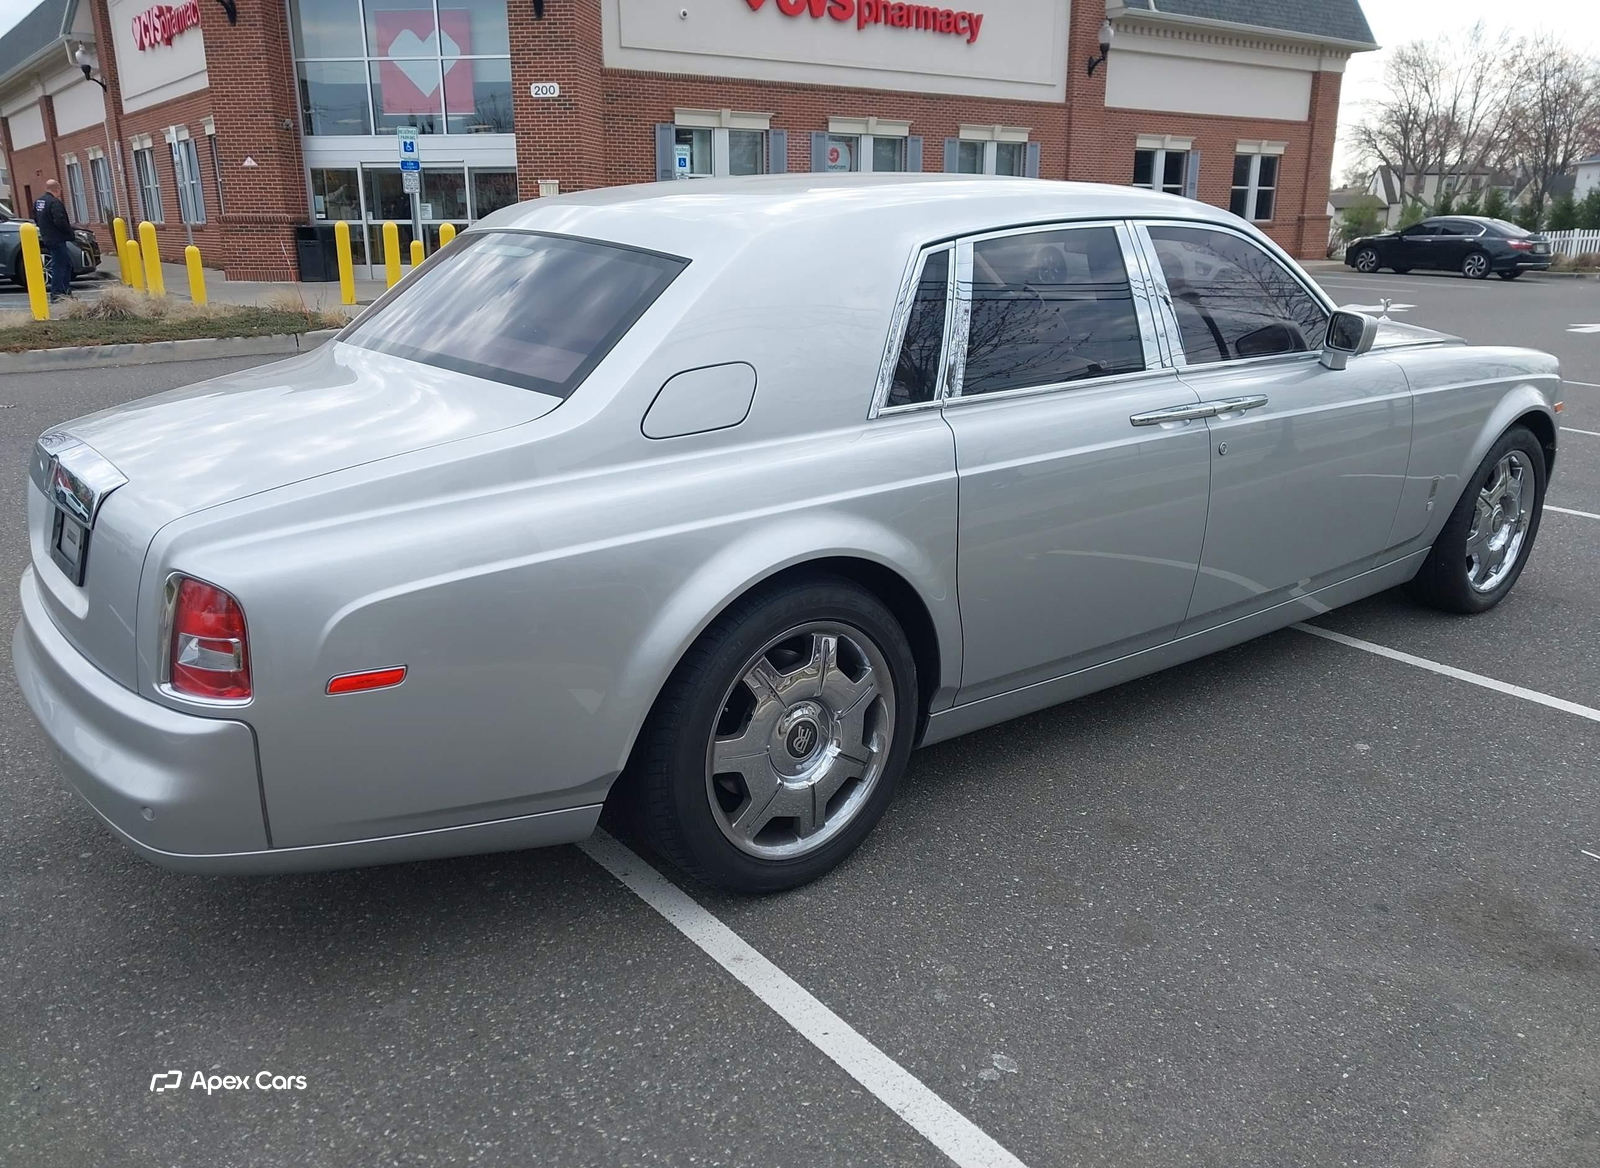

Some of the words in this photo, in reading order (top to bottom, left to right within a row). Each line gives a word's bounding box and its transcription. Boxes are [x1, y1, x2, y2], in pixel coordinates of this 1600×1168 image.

[140, 5, 161, 48] CVS
[857, 0, 984, 44] pharmacy
[534, 85, 556, 96] 200
